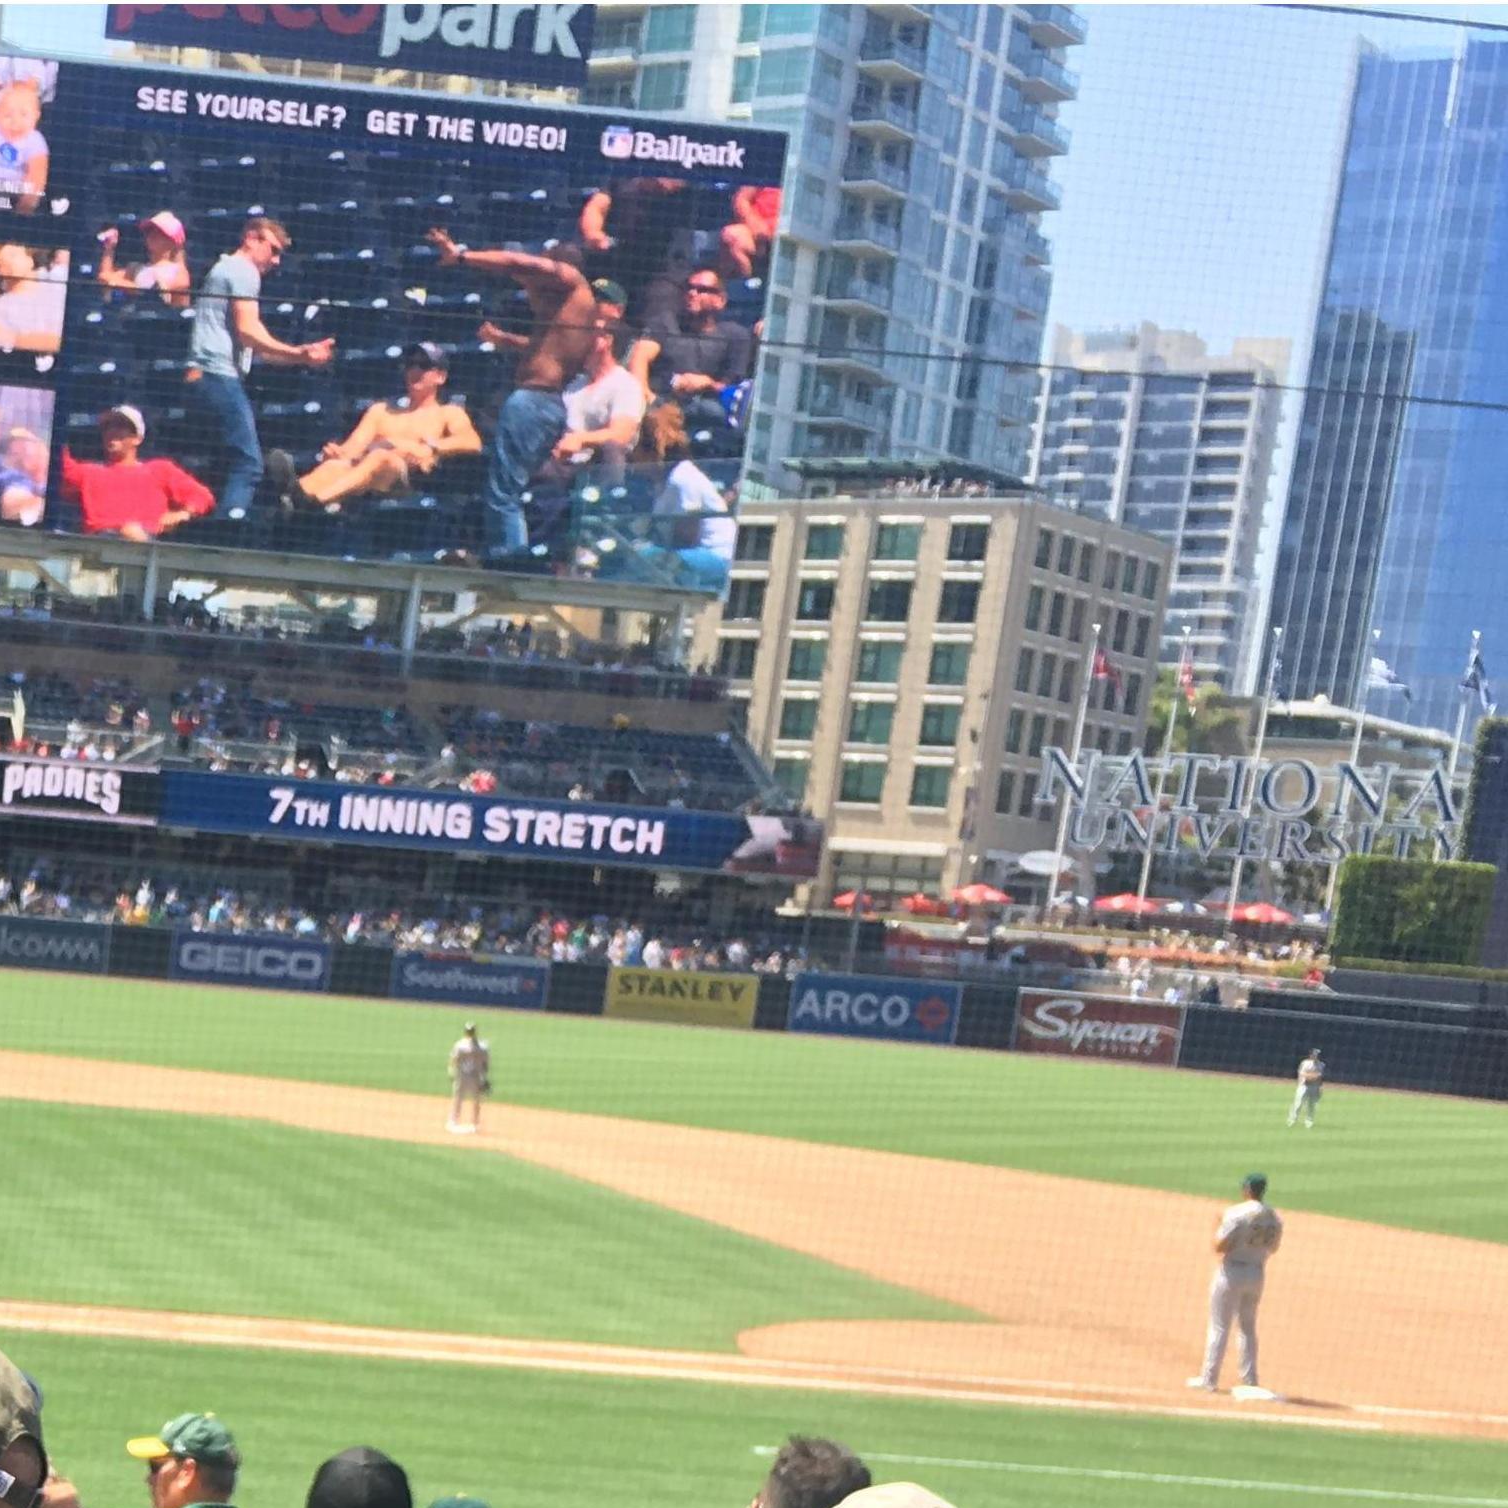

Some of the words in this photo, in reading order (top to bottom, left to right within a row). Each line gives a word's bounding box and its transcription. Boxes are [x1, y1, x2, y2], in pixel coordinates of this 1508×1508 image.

[136, 86, 188, 114] SEE
[196, 92, 347, 130] YOURSELF?
[367, 109, 418, 136] GET
[425, 116, 474, 142] THE
[482, 121, 567, 152] VIDEO!
[633, 131, 745, 169] Ballpark
[2, 763, 121, 815] PADRES
[339, 795, 471, 840] INNING
[483, 807, 665, 856] STRETCH
[1069, 804, 1464, 863] UNIVERSITY
[178, 942, 324, 980] GEICO
[403, 963, 519, 994] Southwest
[618, 973, 746, 1002] STANLEY
[795, 989, 910, 1028] ARCO
